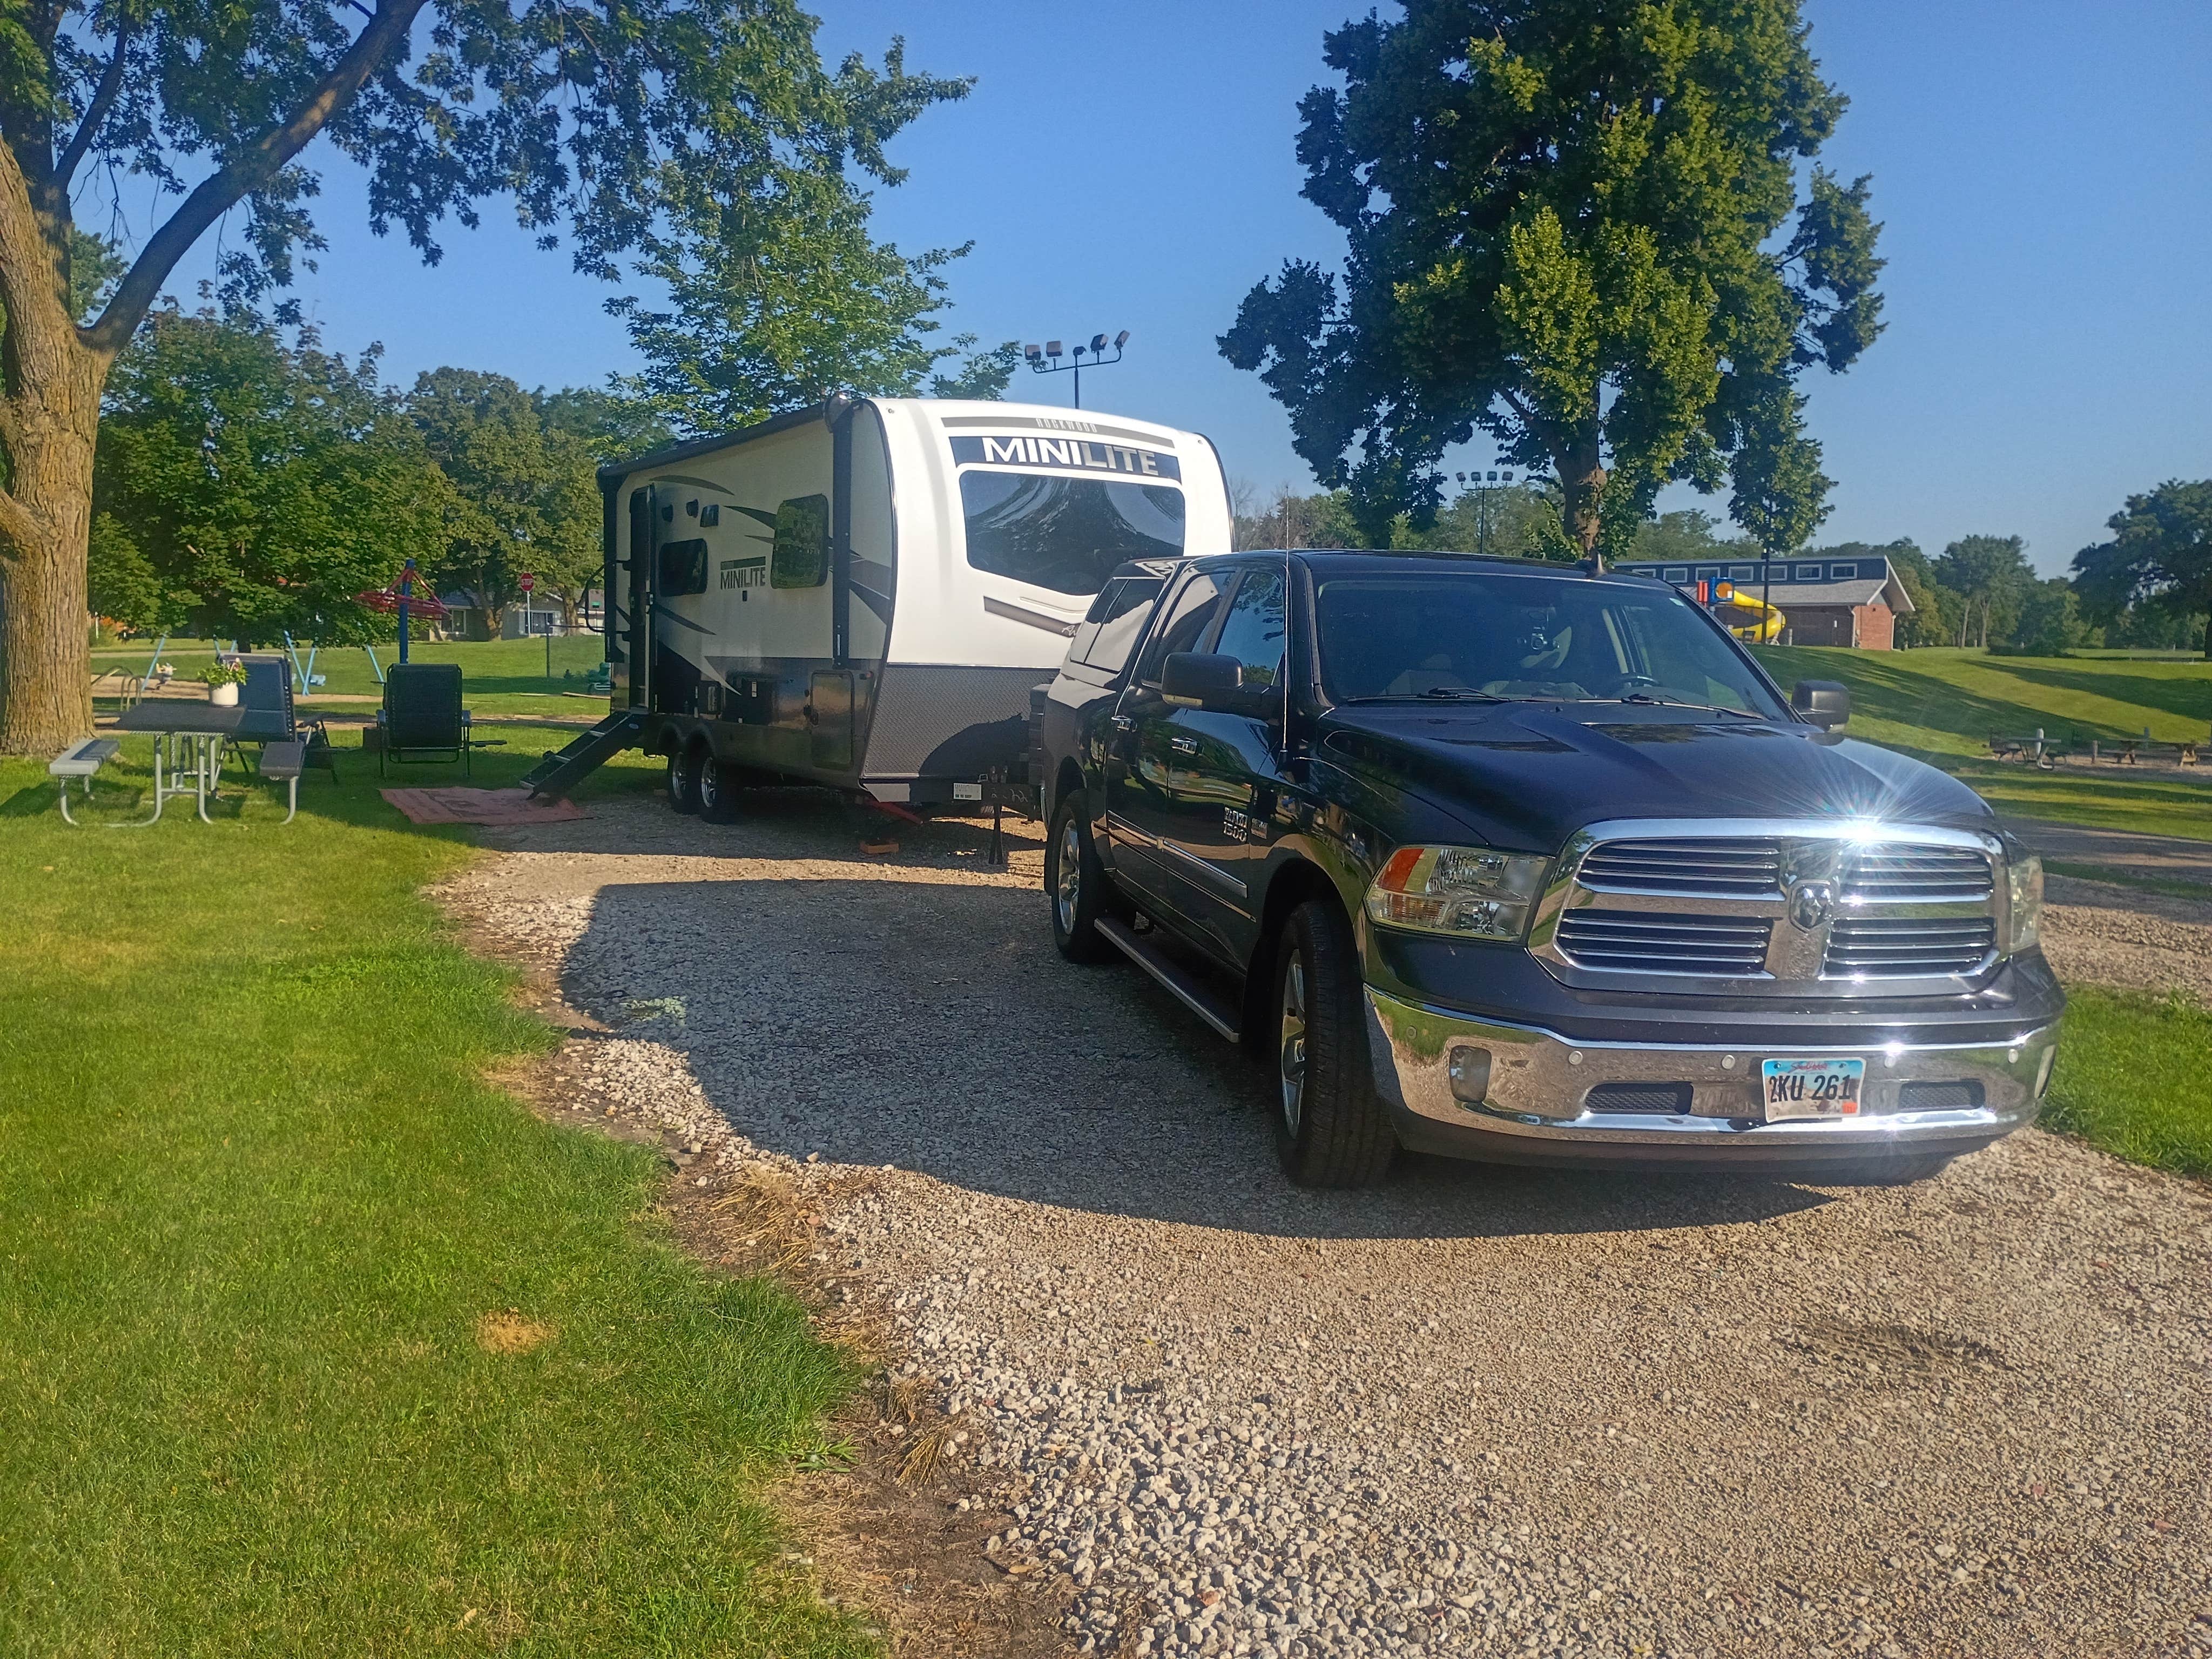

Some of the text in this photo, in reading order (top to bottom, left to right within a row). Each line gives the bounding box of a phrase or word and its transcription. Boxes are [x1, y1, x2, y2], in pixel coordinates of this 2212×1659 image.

[1036, 418, 1097, 433] ROCKWOOD
[982, 437, 1158, 476] MINILITE
[720, 567, 766, 590] MINILITE
[1224, 807, 1248, 828] RAM
[1224, 821, 1247, 841] 1500
[1770, 1075, 1850, 1103] 2KU 261
